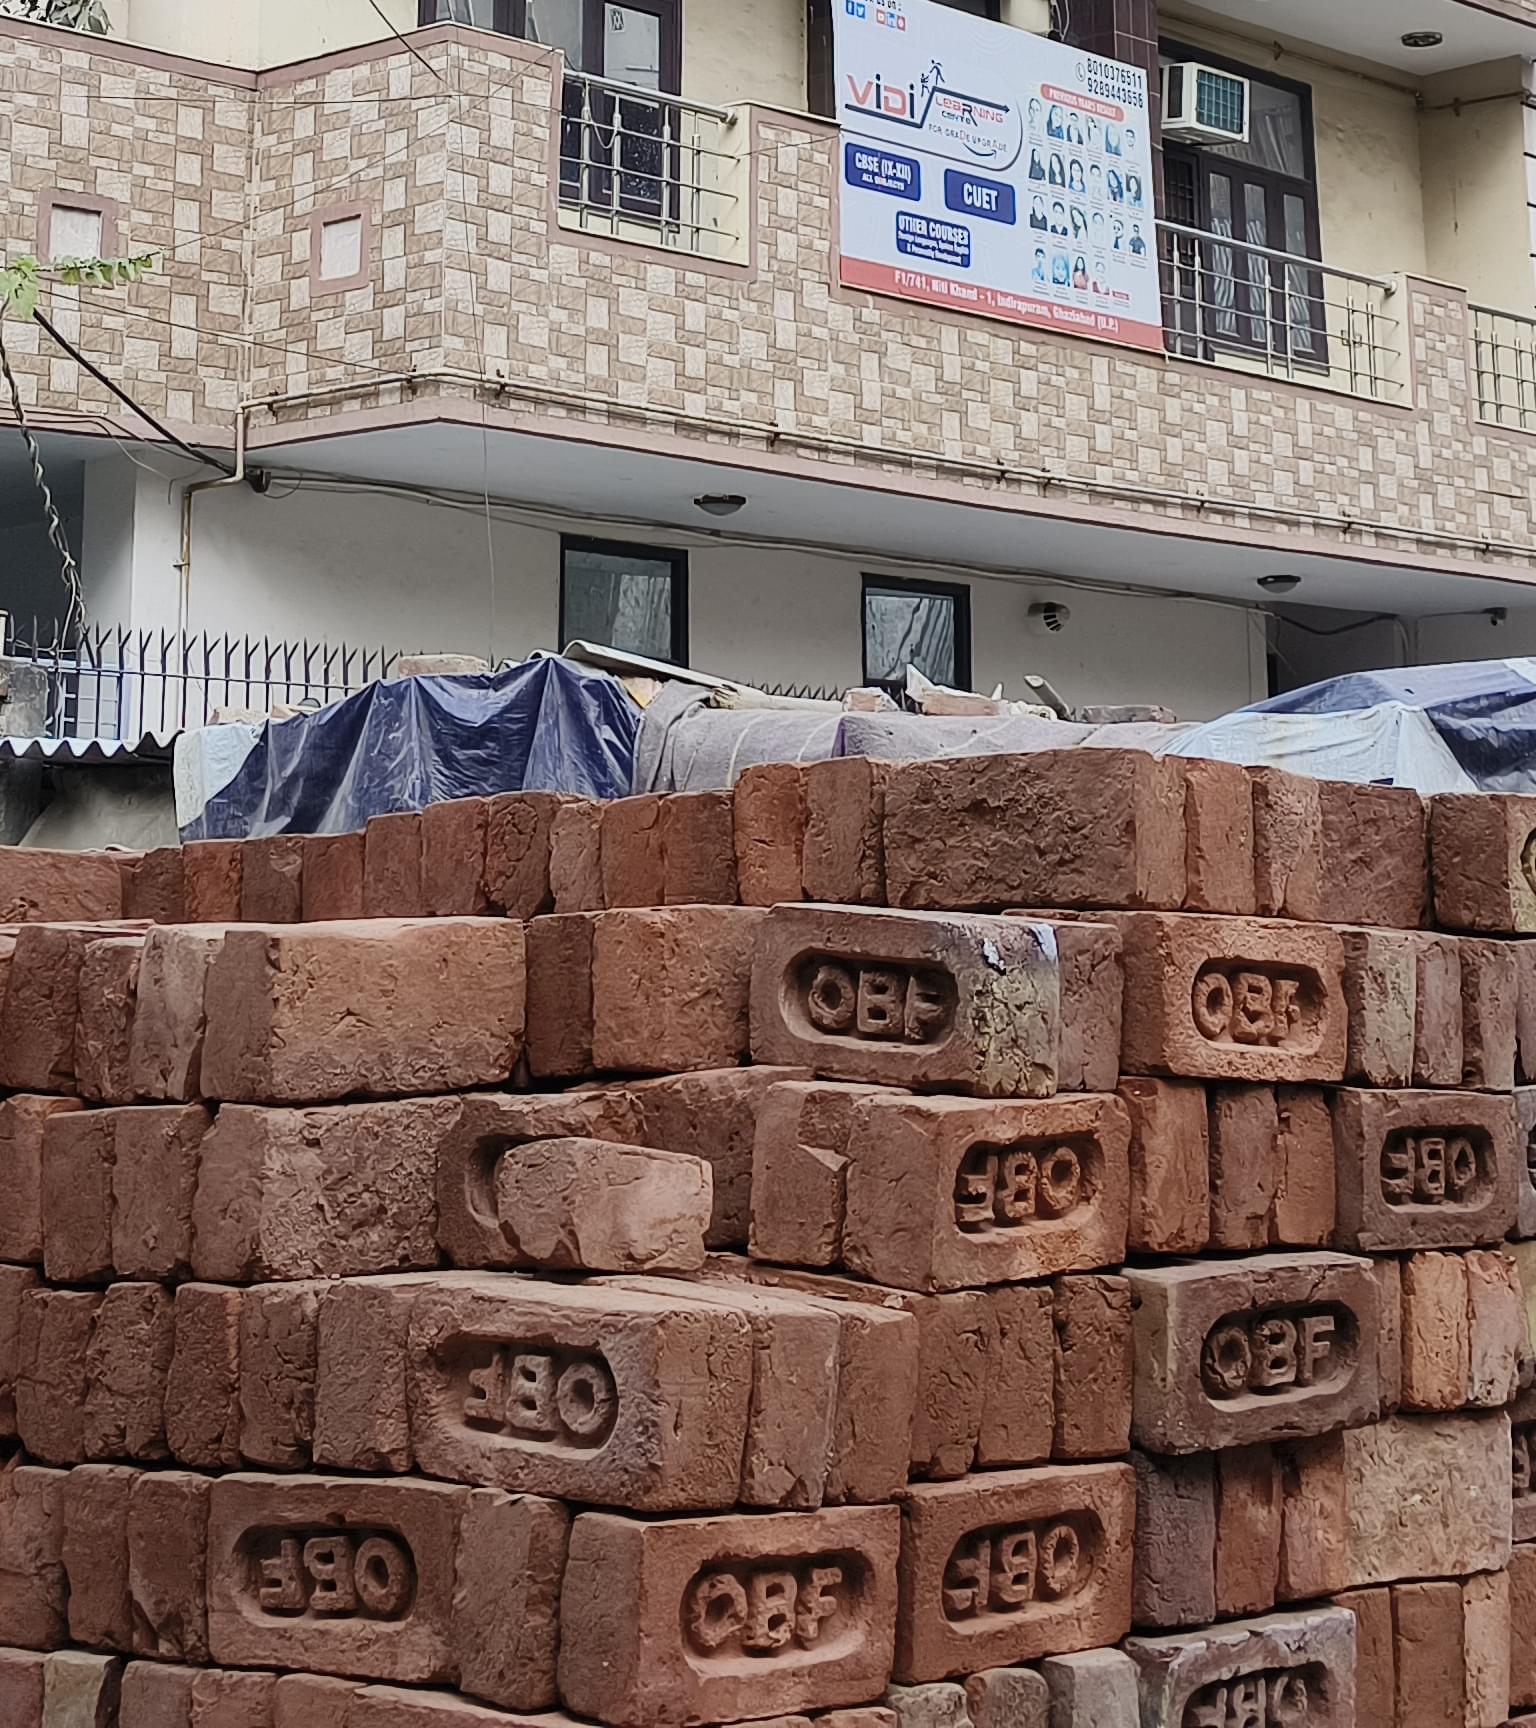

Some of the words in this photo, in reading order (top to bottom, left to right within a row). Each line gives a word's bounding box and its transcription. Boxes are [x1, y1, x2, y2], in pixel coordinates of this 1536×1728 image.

[1087, 58, 1142, 89] 8010376511
[1087, 77, 1143, 108] 9289443656
[855, 152, 879, 172] CBSE
[881, 159, 912, 184] (IX-XII)
[963, 183, 999, 211] CUET
[898, 215, 927, 236] OTHER
[929, 221, 969, 245] COURSES
[950, 282, 977, 300] Khand
[808, 964, 949, 1040] OBF
[1194, 973, 1300, 1040] OBF
[955, 1146, 1081, 1222] OBF
[1381, 1137, 1476, 1195] OBF
[1207, 1315, 1335, 1390] OBF
[464, 1352, 616, 1435] OBF
[260, 1535, 411, 1613] OBF
[944, 1525, 1080, 1611] OBF
[692, 1566, 843, 1648] OBF
